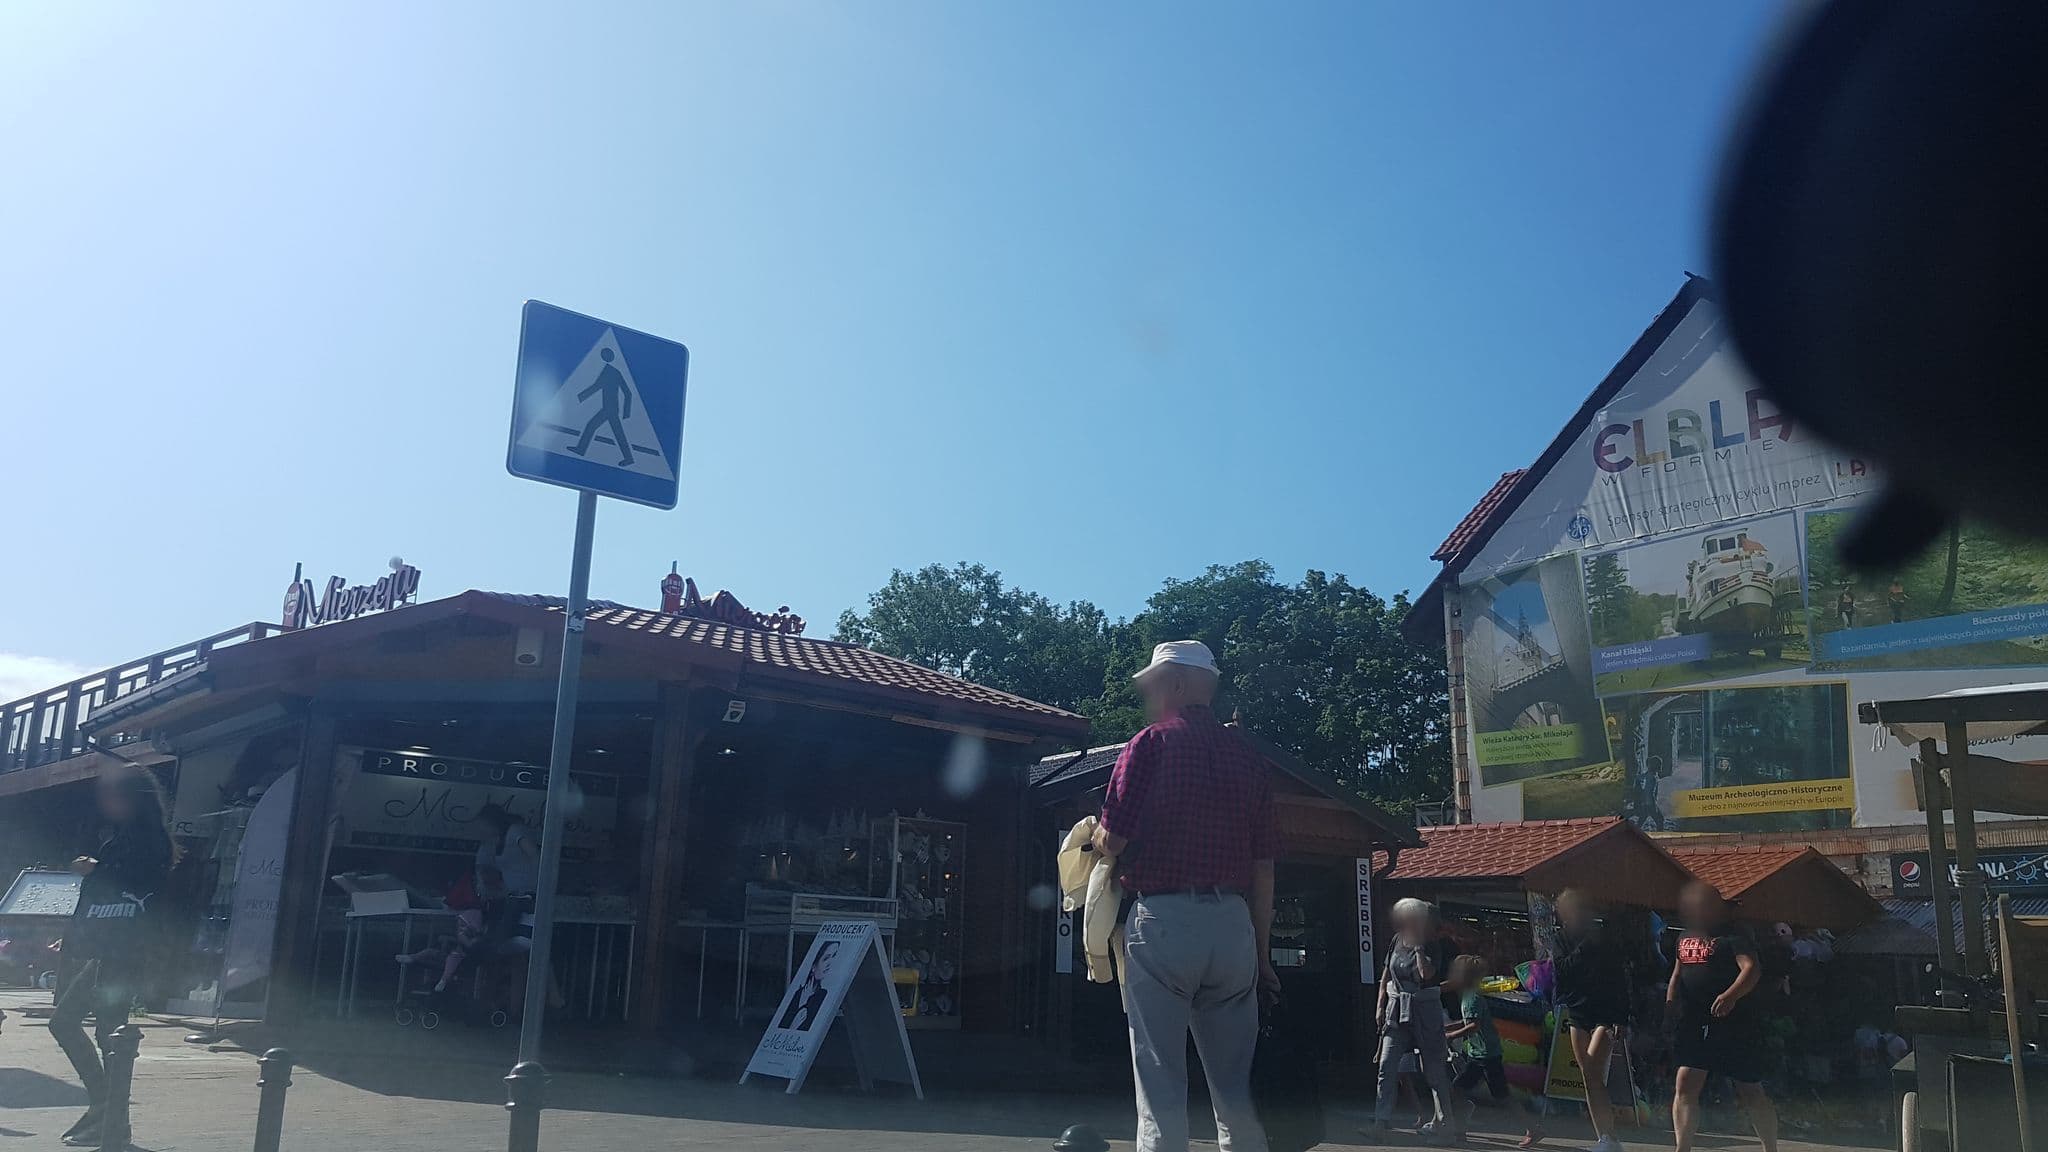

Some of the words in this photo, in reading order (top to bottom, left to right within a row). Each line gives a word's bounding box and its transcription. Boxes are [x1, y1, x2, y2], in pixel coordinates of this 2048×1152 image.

[1602, 472, 1622, 487] W
[1641, 439, 1774, 479] FORMIE
[1607, 509, 1655, 528] Sponsor
[1658, 492, 1732, 517] strategiczny
[1736, 484, 1770, 502] cyklu
[1774, 473, 1822, 495] imprez
[1972, 610, 2026, 626] Bieszczady
[1601, 649, 1622, 659] Kanał
[1688, 793, 1723, 802] Muzeum
[1724, 784, 1843, 800] Archeologiczno-Historyczne
[1701, 803, 1721, 812] jedno
[1815, 795, 1844, 806] Europie
[87, 904, 136, 918] PUMA
[1360, 864, 1371, 952] SREBRO
[820, 924, 869, 935] PRODUCENT
